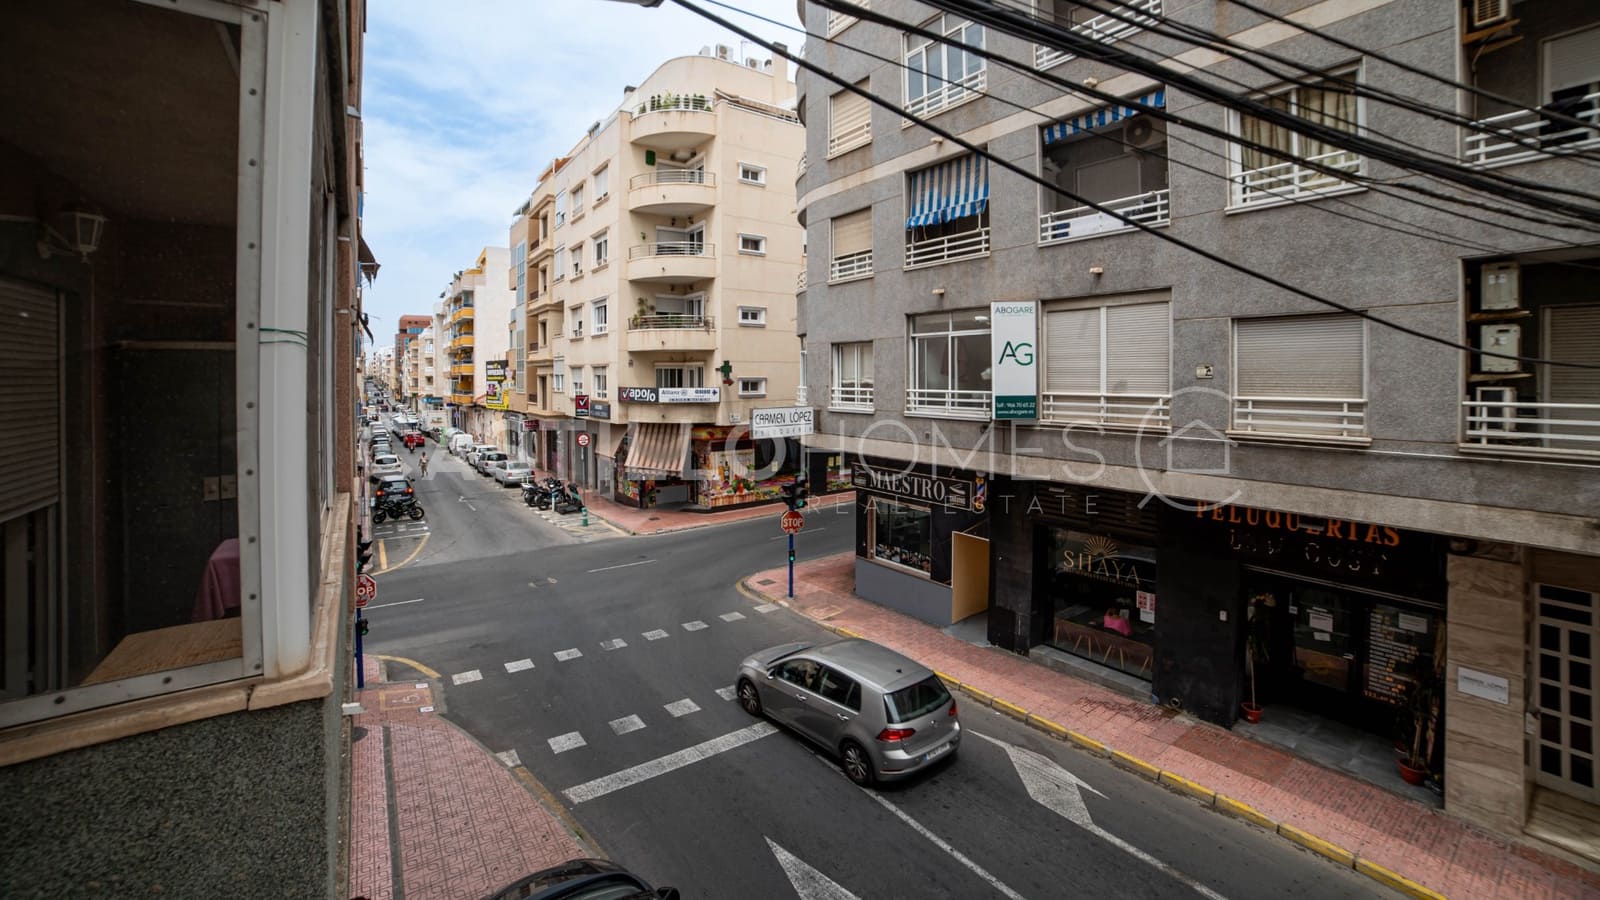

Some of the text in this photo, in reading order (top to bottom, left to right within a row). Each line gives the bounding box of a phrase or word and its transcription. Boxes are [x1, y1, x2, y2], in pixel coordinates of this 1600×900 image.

[994, 306, 1034, 315] ABOGARE
[998, 340, 1034, 366] AG
[629, 387, 656, 402] apolo
[754, 413, 786, 426] CARMEN
[789, 408, 812, 424] LÓPEZ
[869, 470, 946, 501] MAESTRO
[783, 518, 803, 528] STOP
[1063, 550, 1141, 585] SHAYA
